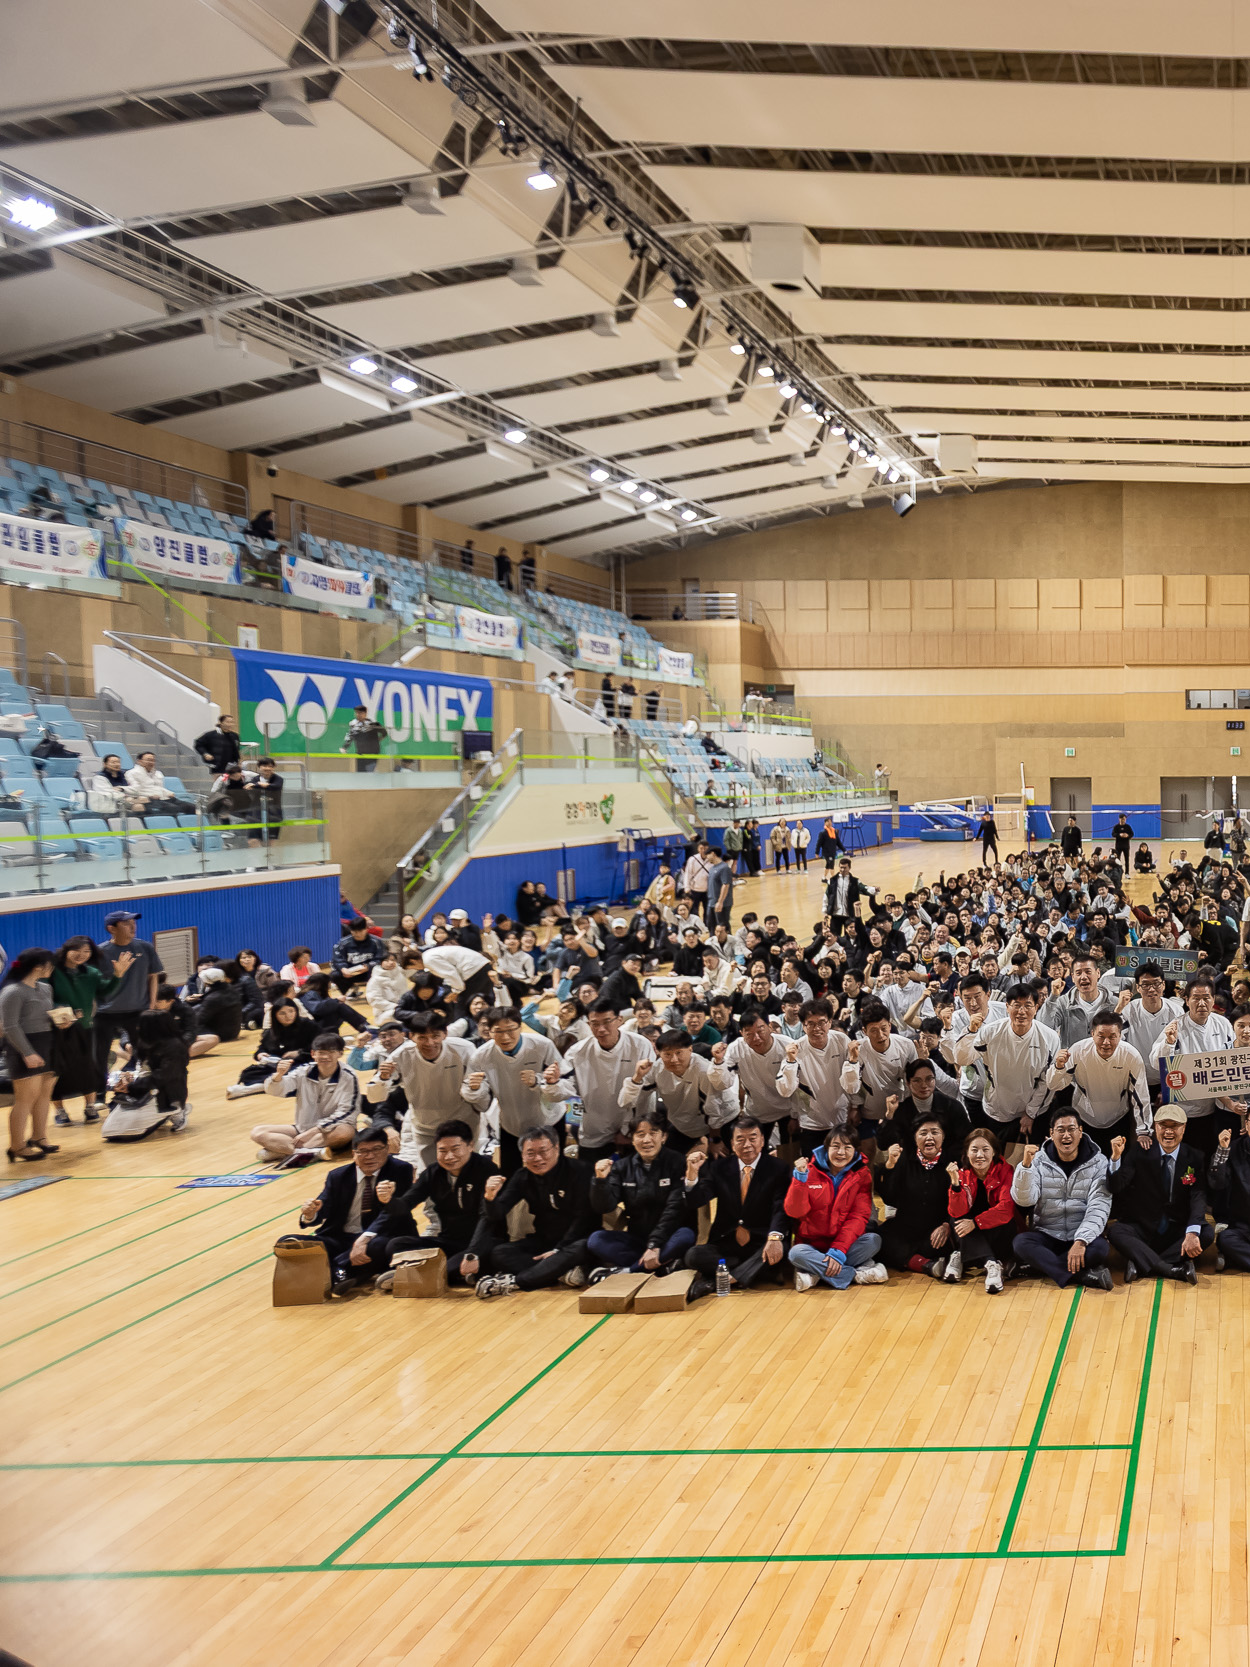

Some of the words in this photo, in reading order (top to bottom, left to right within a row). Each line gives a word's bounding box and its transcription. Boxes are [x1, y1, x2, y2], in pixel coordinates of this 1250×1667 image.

[354, 677, 482, 743] YONEX
[1194, 1056, 1227, 1069] 제31회
[1169, 1072, 1183, 1087] 필
[1208, 1085, 1233, 1093] 서울특별시
